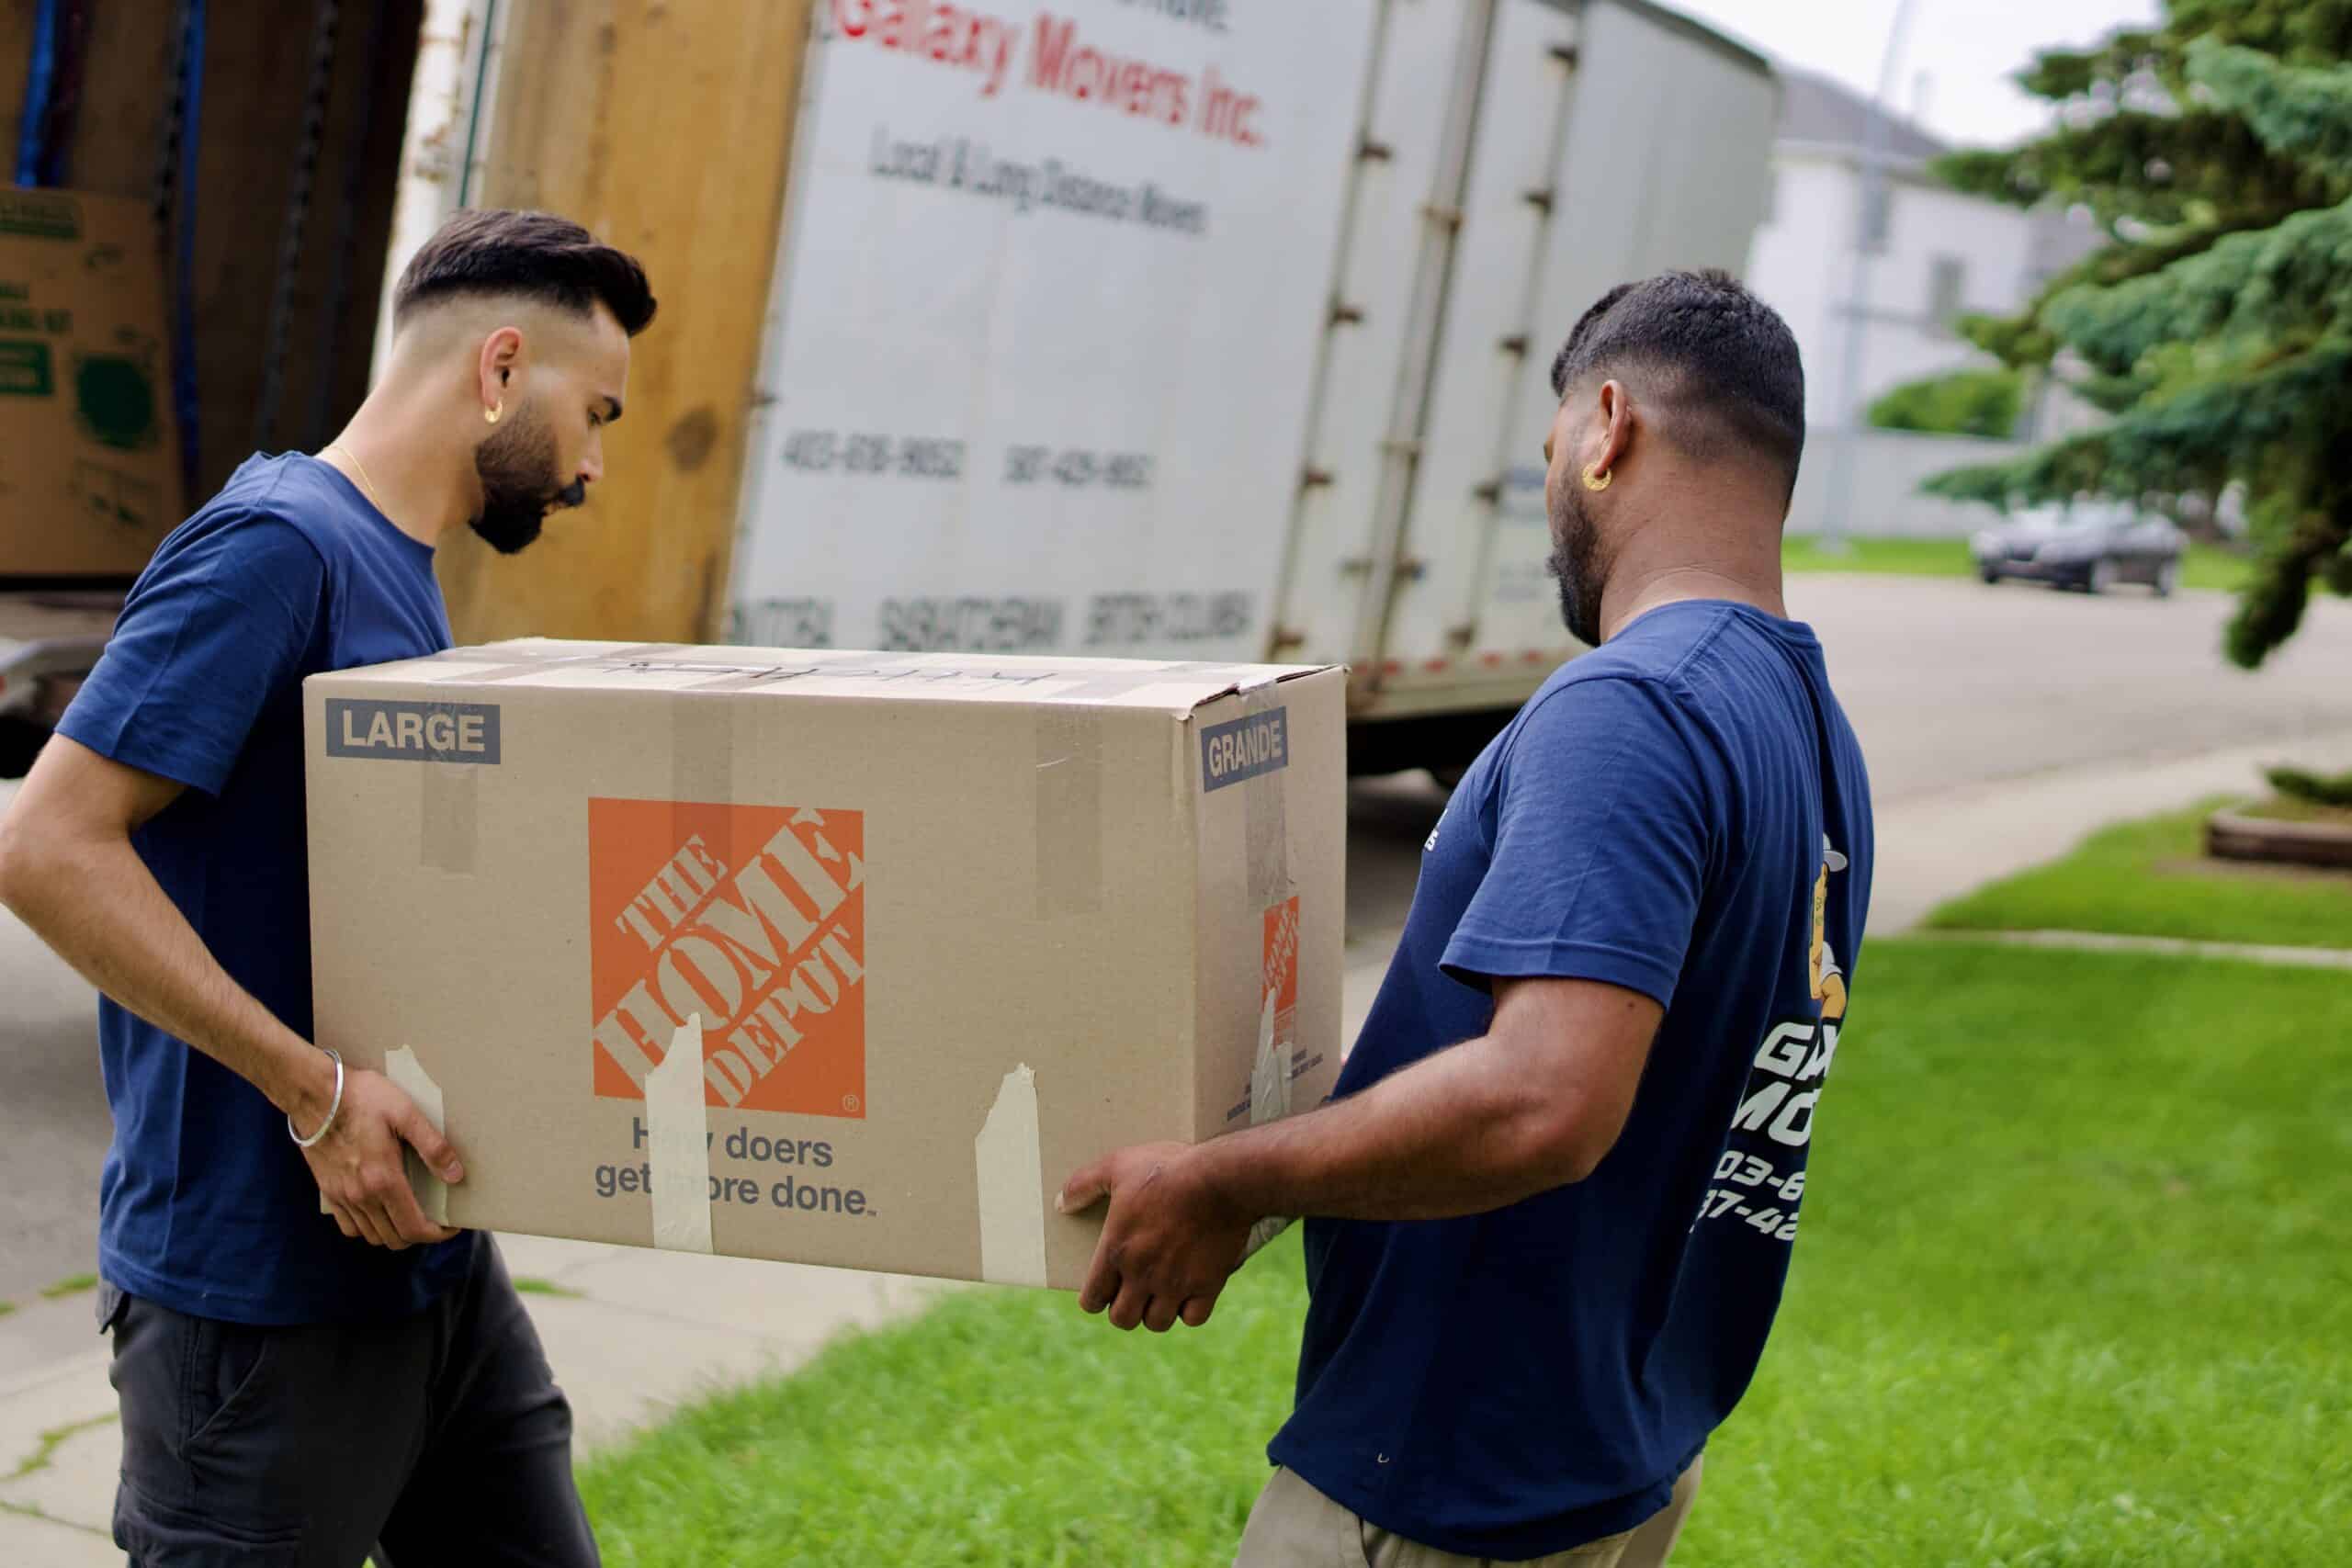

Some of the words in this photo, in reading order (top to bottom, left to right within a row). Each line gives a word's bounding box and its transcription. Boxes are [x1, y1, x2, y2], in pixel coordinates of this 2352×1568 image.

[1026, 13, 1190, 126] Movers
[343, 709, 485, 752] LARGE
[1208, 720, 1283, 777] GRANDE
[615, 834, 728, 953] THE
[594, 807, 865, 1098] HOME
[703, 923, 865, 1107] DEPOT
[594, 1162, 651, 1198] get
[725, 1126, 833, 1168] doers
